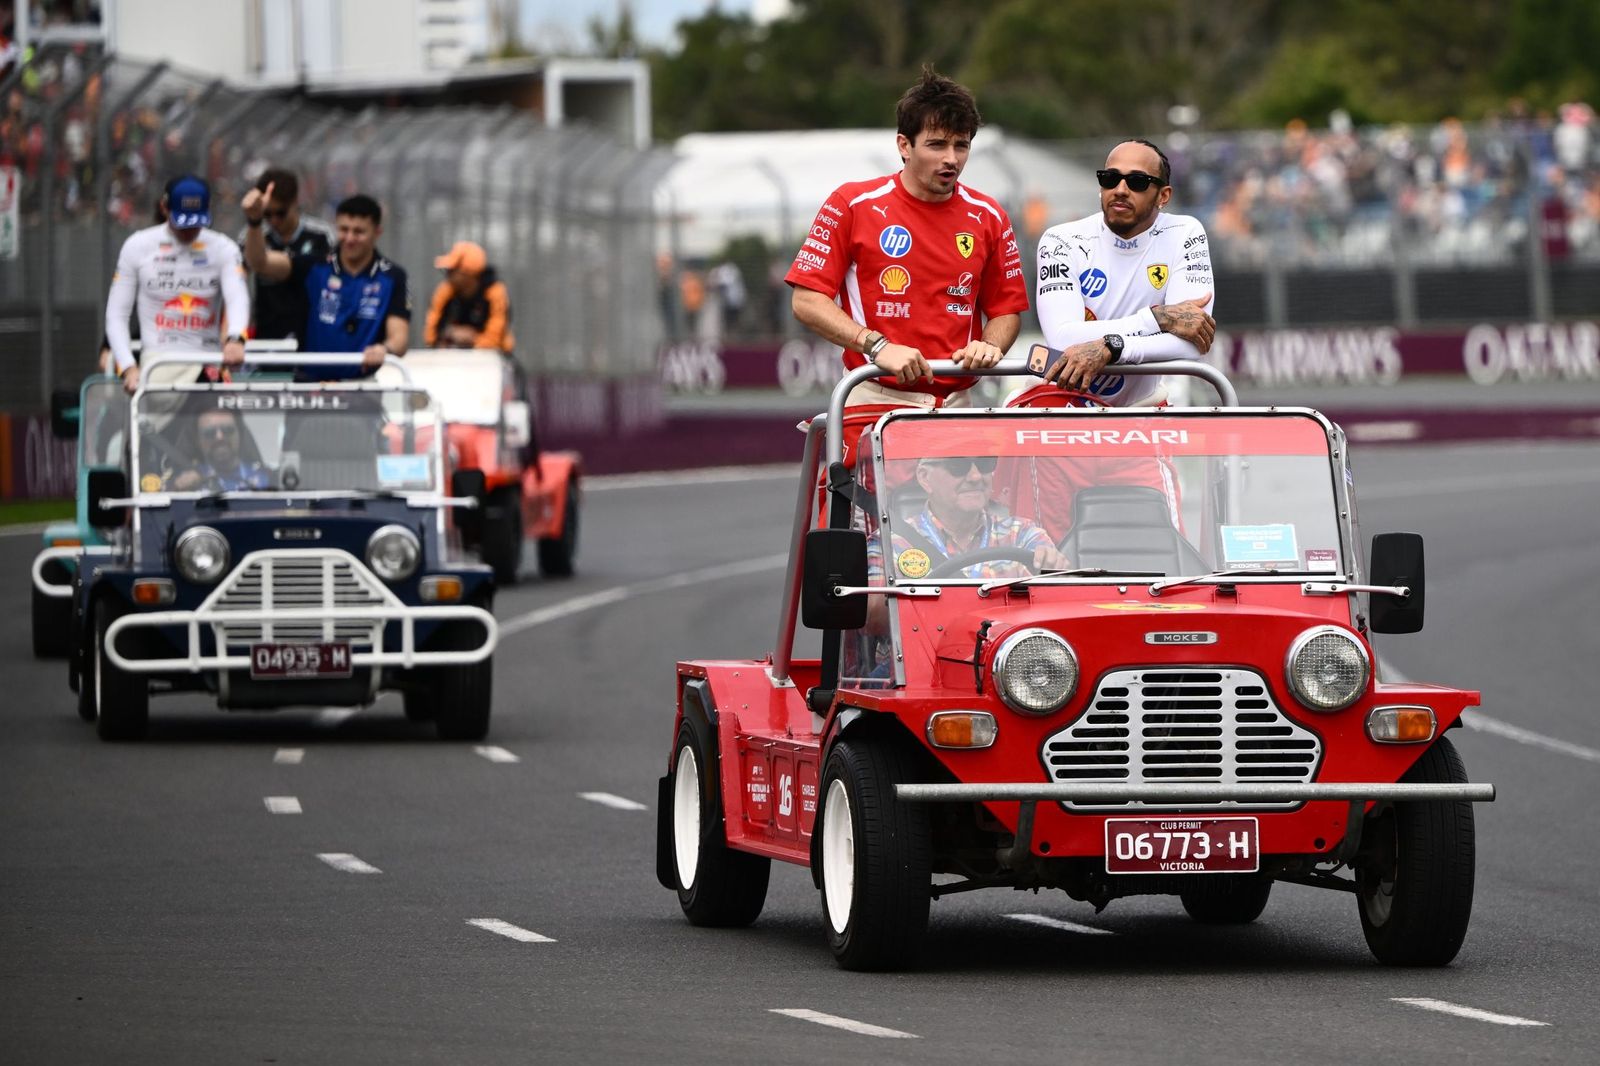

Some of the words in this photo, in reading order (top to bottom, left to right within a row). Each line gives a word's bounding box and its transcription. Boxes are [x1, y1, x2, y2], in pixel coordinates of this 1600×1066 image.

[817, 213, 838, 229] ENESYS
[883, 225, 908, 258] hp
[1113, 237, 1139, 249] IBM
[798, 250, 826, 267] ERONI
[1190, 250, 1208, 260] GENE
[1006, 267, 1022, 279] Bin
[1186, 275, 1212, 285] WHOO
[1039, 282, 1074, 296] PIRELLI
[1081, 268, 1107, 298] hp
[875, 301, 911, 318] IBM
[218, 396, 274, 409] RED
[279, 394, 348, 410] BULL
[1016, 430, 1189, 444] FERRARI
[1163, 634, 1199, 642] MOKE
[256, 647, 321, 670] 04935
[779, 773, 792, 817] 16
[1160, 822, 1177, 830] CLUB
[1178, 821, 1202, 830] PERMIT
[1159, 862, 1205, 871] VICTORIA
